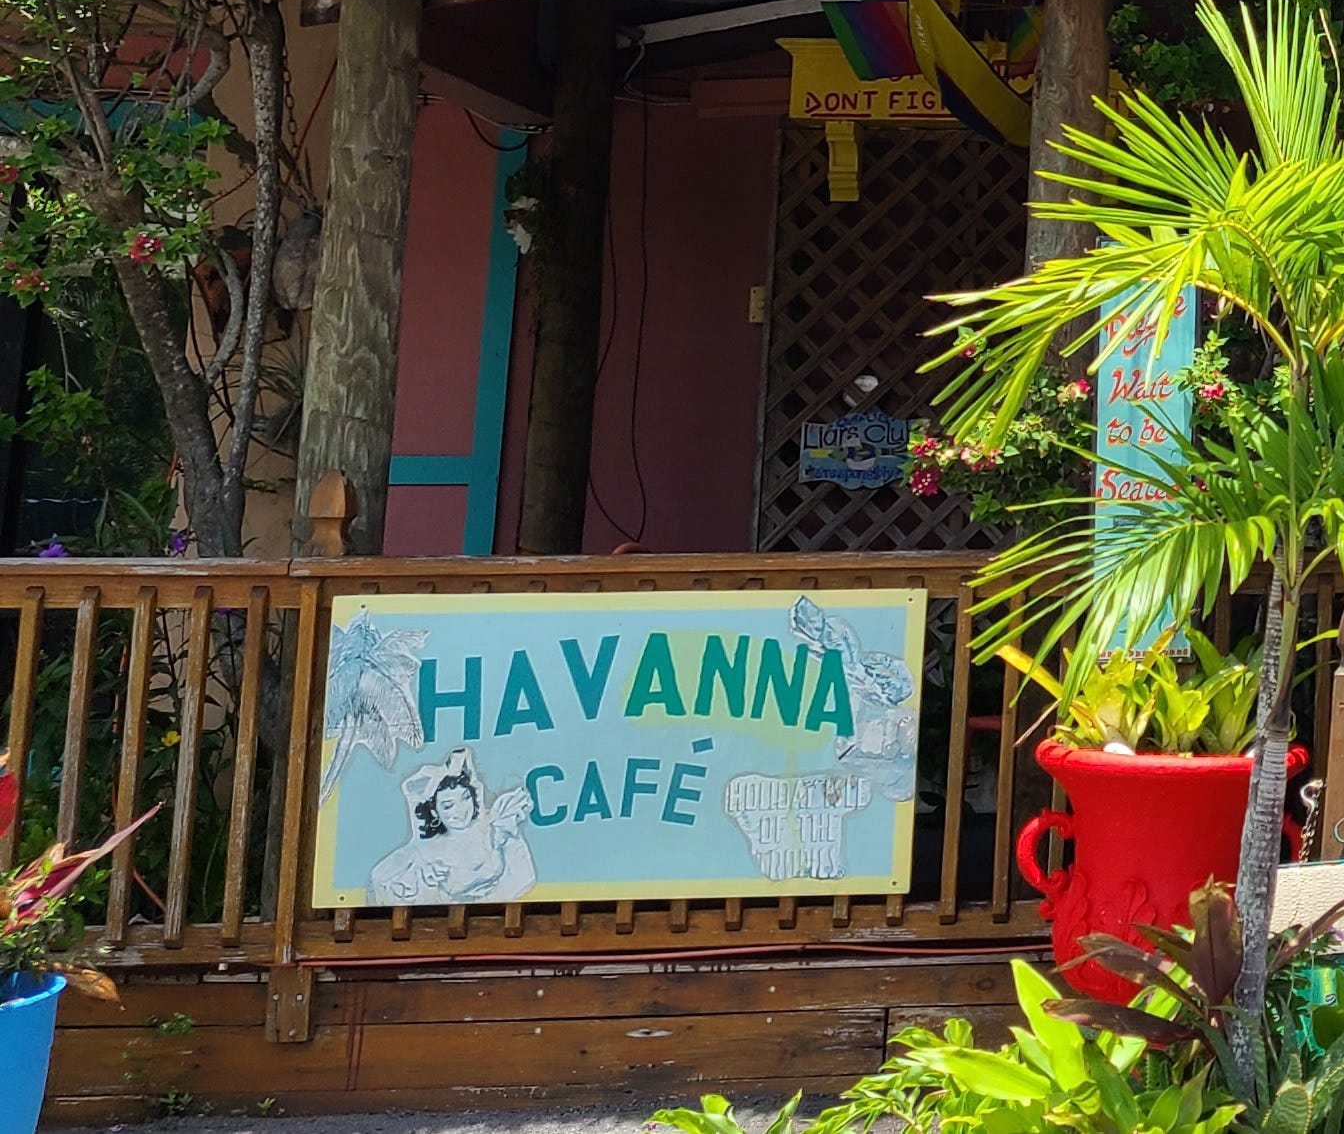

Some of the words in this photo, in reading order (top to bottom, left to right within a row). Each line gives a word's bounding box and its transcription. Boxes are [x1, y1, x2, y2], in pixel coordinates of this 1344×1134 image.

[889, 90, 946, 110] FIG
[1108, 368, 1173, 405] Wait
[804, 424, 860, 449] Liars
[1107, 418, 1133, 444] to
[1140, 417, 1169, 444] be
[417, 632, 855, 743] HAVANNA
[527, 737, 715, 827] CAFÉ
[759, 815, 787, 844] OF
[799, 814, 838, 842] THE
